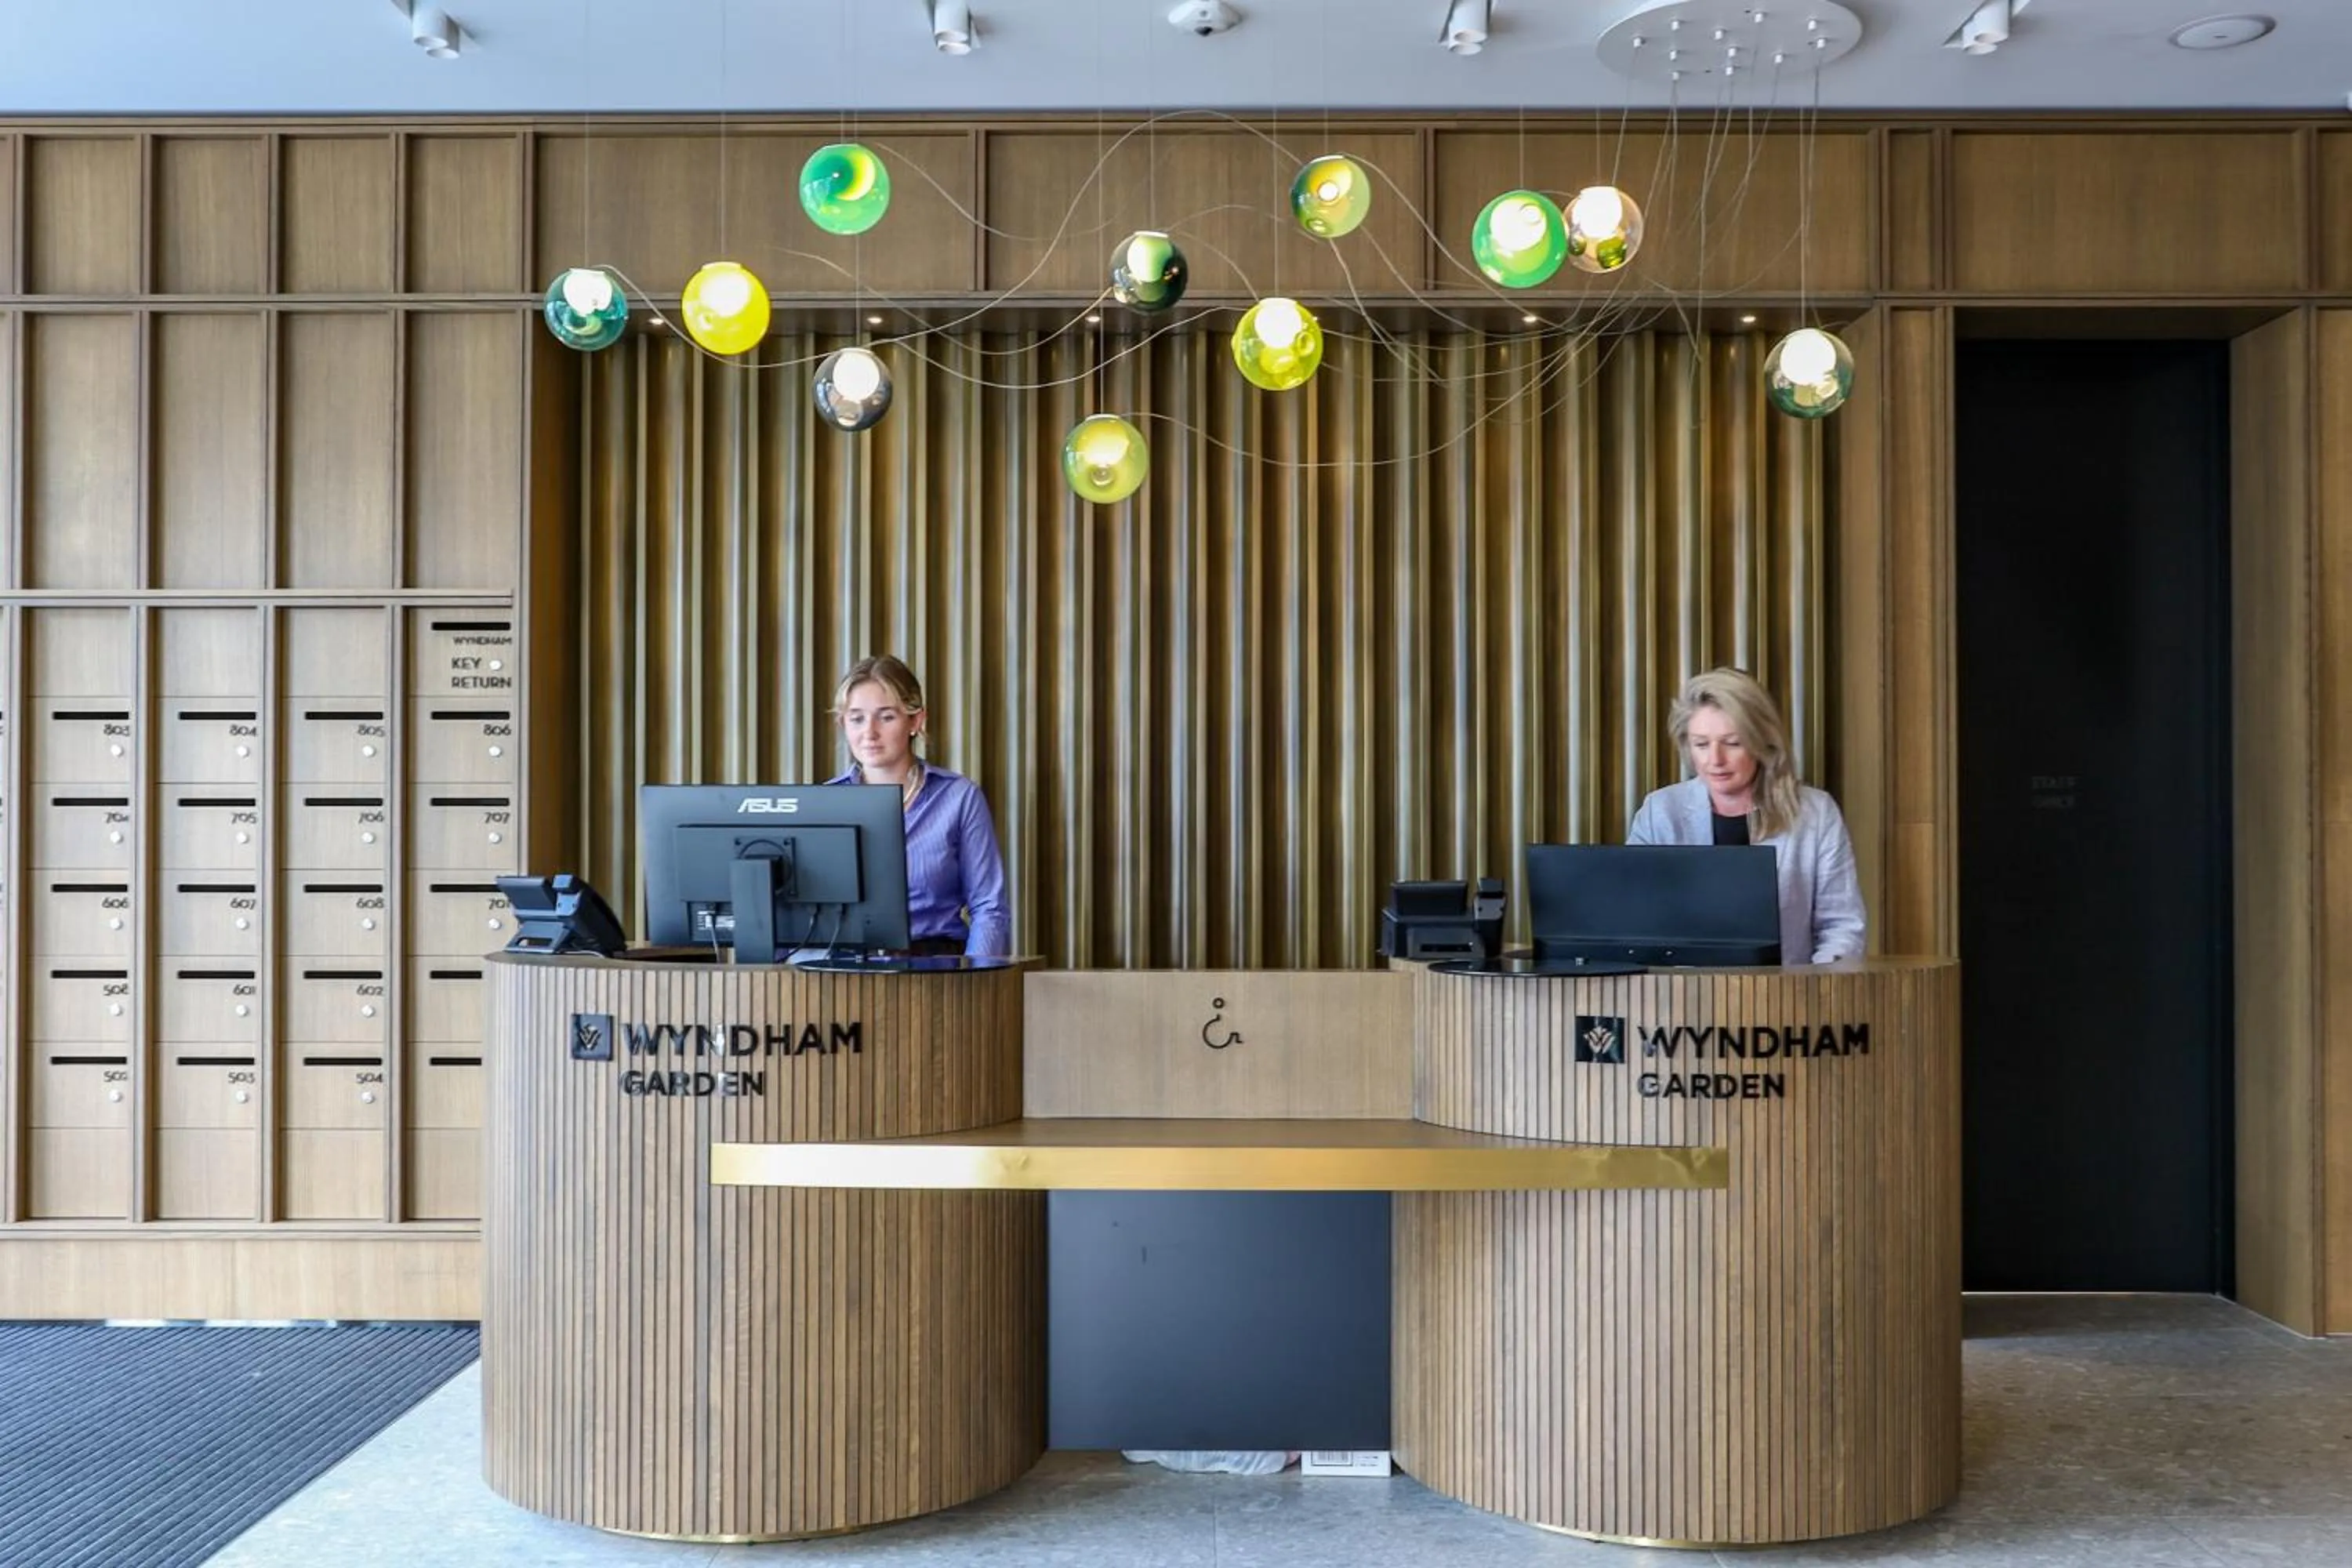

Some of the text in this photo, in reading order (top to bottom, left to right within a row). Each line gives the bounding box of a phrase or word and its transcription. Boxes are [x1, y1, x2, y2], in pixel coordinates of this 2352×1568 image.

[452, 636, 513, 645] WYNDHAM
[452, 657, 482, 669] KEY
[452, 677, 512, 688] RETURN
[358, 724, 385, 736] 805
[484, 724, 511, 736] 806
[738, 797, 798, 813] ASUS
[231, 812, 257, 823] 705
[358, 811, 385, 823] 706
[485, 811, 511, 823] 707
[230, 898, 256, 909] 607
[356, 898, 385, 909] 608
[357, 984, 383, 996] 602
[623, 1021, 863, 1056] WYNDHAM
[1637, 1023, 1870, 1058] WYNDHAM
[228, 1072, 256, 1083] 503
[357, 1073, 383, 1084] 504
[622, 1070, 764, 1097] GARDEN
[1638, 1073, 1786, 1098] GARDEN
